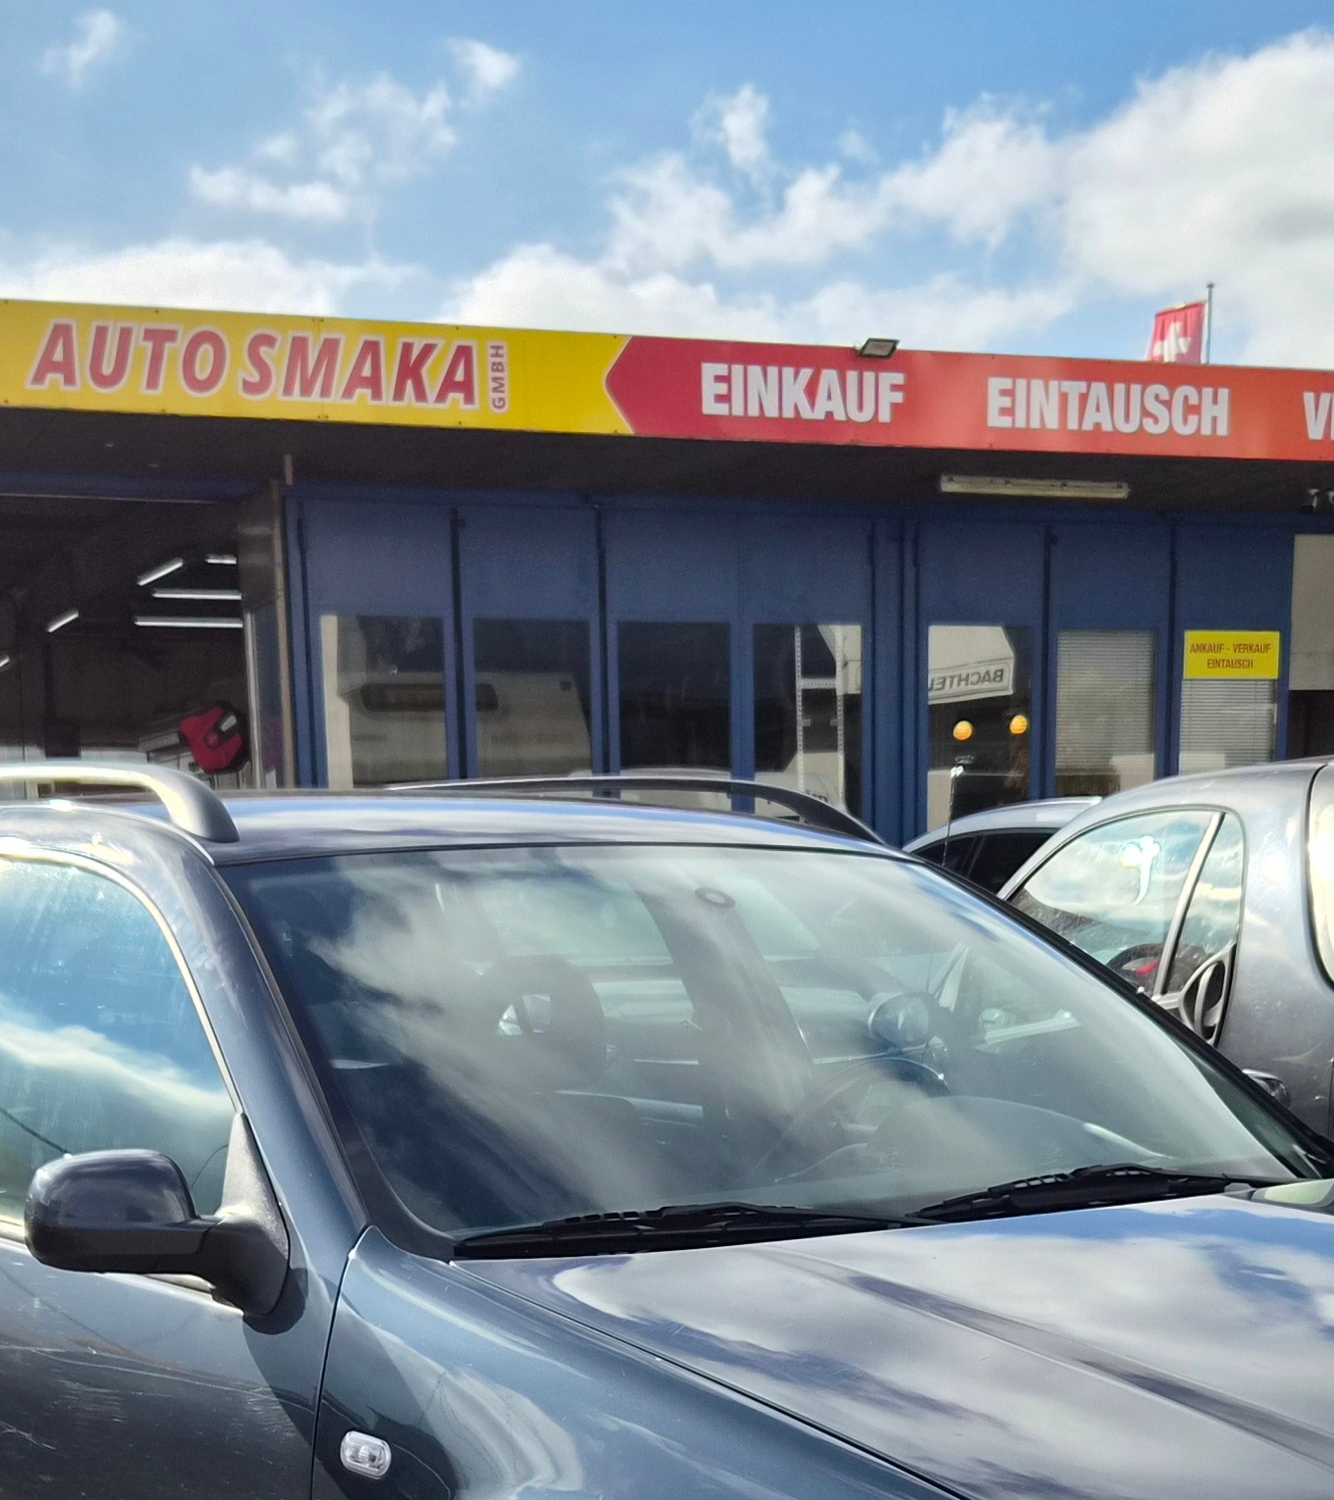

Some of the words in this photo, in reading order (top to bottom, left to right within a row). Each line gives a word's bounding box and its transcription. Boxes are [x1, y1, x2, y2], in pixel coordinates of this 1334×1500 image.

[28, 321, 228, 395] AUTO
[240, 330, 477, 406] SMAKA
[489, 343, 507, 410] GMBH
[701, 362, 905, 423] EINKAUF
[987, 377, 1230, 436] EINTAUSCH
[1189, 643, 1224, 654] ANKAUF
[1233, 643, 1271, 654] VERKAUF
[1207, 658, 1254, 669] EINTAUSCH
